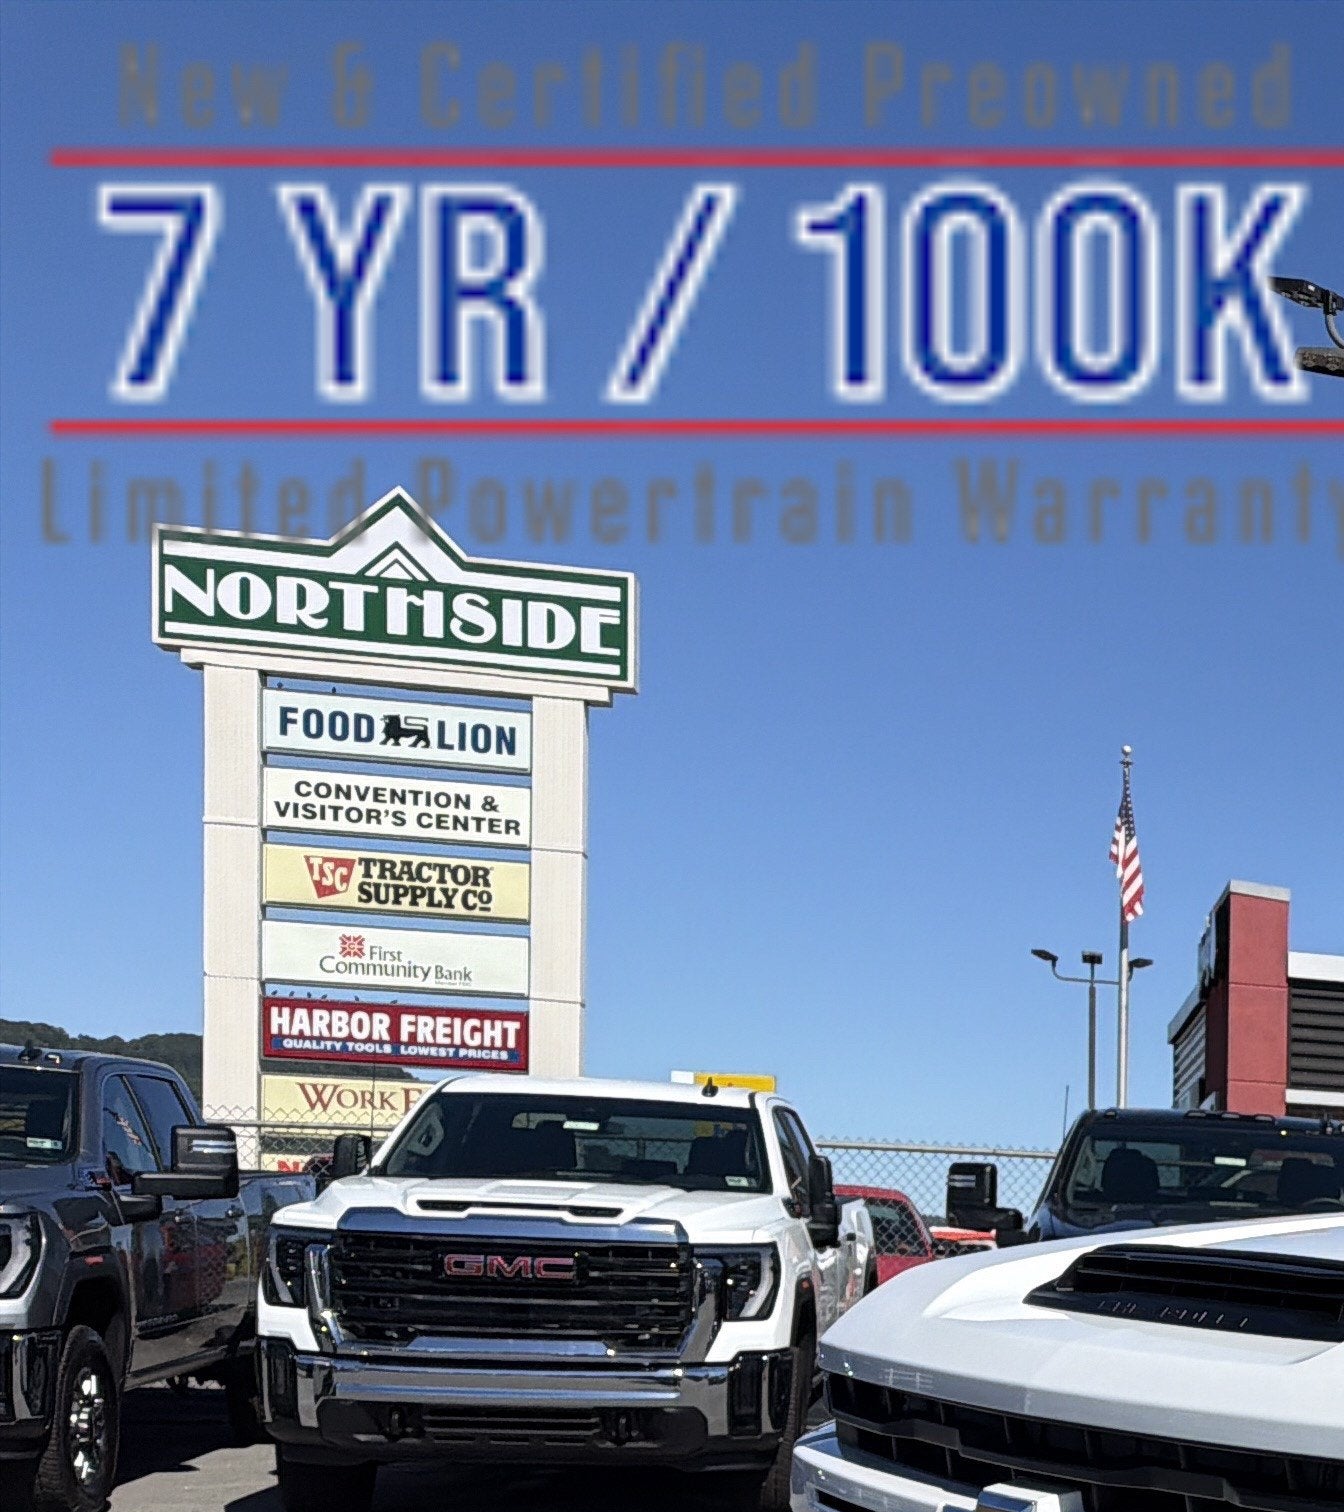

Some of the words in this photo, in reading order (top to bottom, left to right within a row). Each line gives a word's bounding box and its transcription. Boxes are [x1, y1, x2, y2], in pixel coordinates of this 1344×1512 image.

[164, 563, 621, 656] NORTHSIDE
[278, 705, 375, 744] FOOD
[436, 719, 517, 756] LION
[294, 780, 471, 811] CONVENTION
[480, 795, 500, 813] &
[273, 801, 407, 827] VISITOR'S
[416, 811, 521, 836] CENTER
[309, 856, 348, 892] TSC
[357, 857, 492, 888] TRACTOR
[357, 881, 459, 910] SUPPLY
[319, 955, 432, 982] Community
[434, 965, 473, 982] Bank
[369, 945, 403, 963] First
[270, 1006, 391, 1042] HARBOR
[399, 1013, 521, 1049] FREIGHT
[282, 1039, 343, 1052] QUALITY
[346, 1042, 393, 1055] TOOLS
[400, 1046, 456, 1058] LOWEST
[458, 1048, 509, 1061] PRICES
[295, 1082, 399, 1112] WORK
[444, 1253, 575, 1279] GMC
